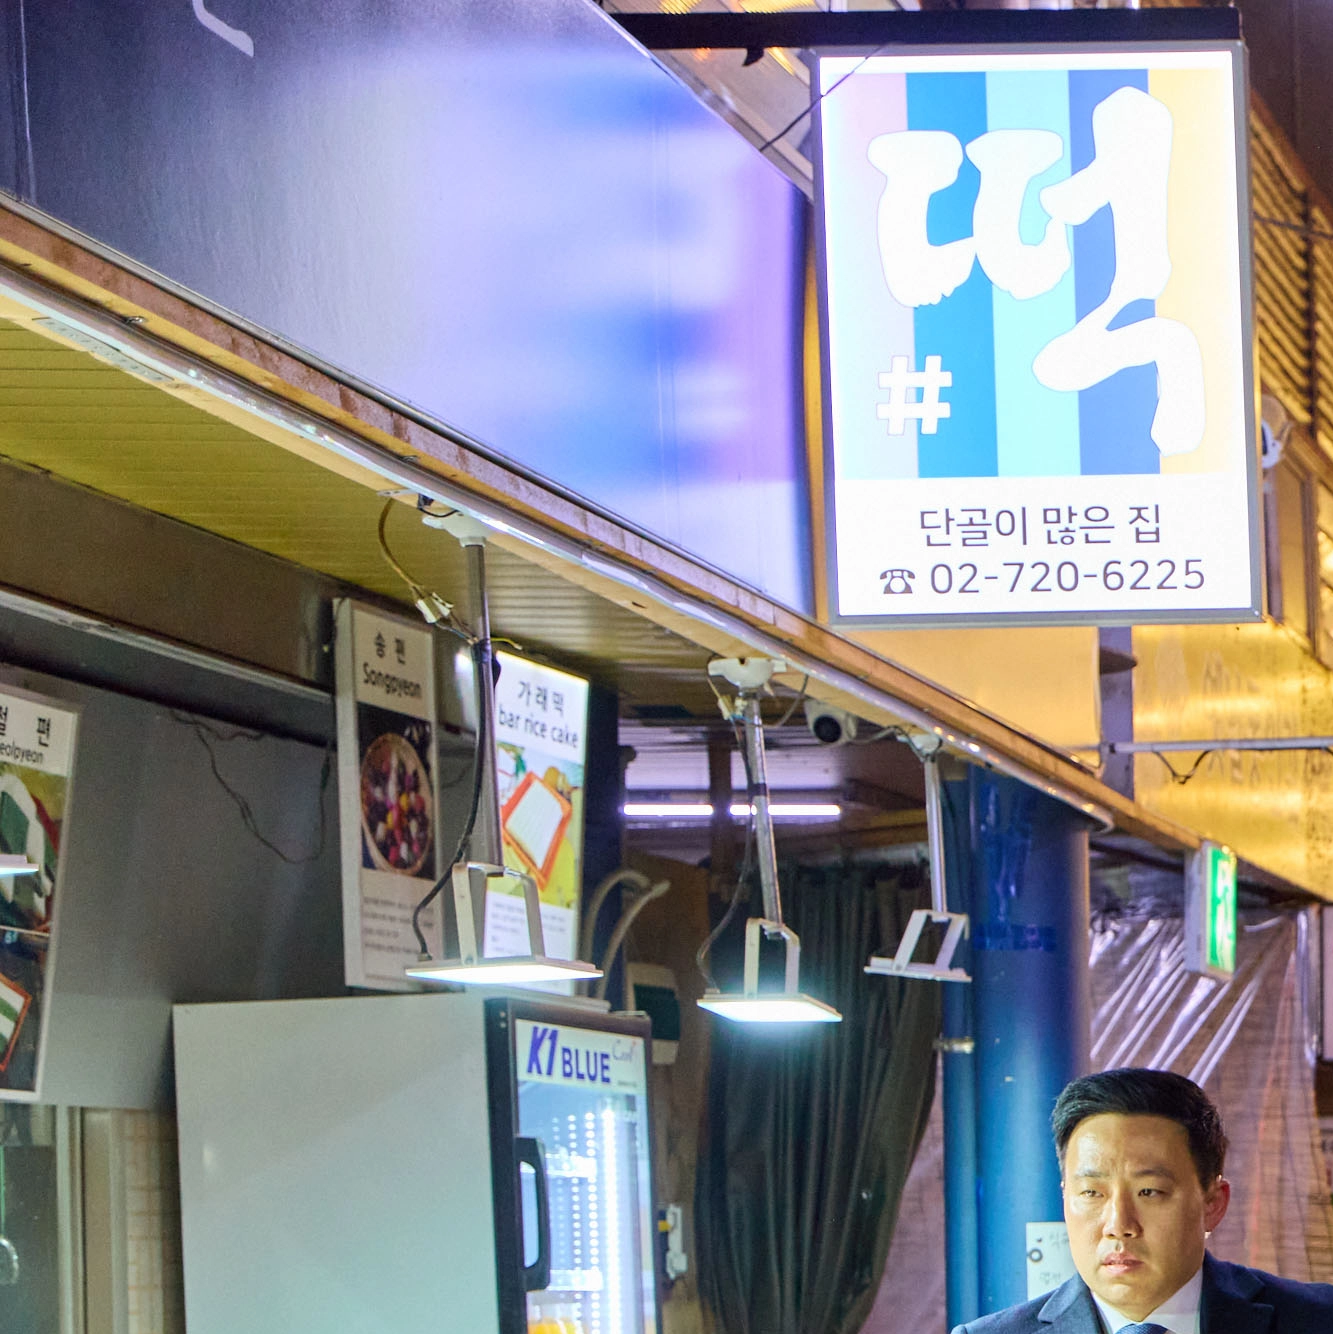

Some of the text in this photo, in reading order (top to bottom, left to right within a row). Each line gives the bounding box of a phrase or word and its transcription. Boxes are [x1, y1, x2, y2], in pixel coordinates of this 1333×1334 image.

[866, 85, 1207, 458] 떡
[919, 506, 1161, 547] 단골이 많은 집
[930, 559, 1206, 595] 02-720-6225
[362, 661, 422, 698] Songpyeon
[498, 703, 579, 748] bar rice cake
[527, 1026, 611, 1084] K1 BLUE
